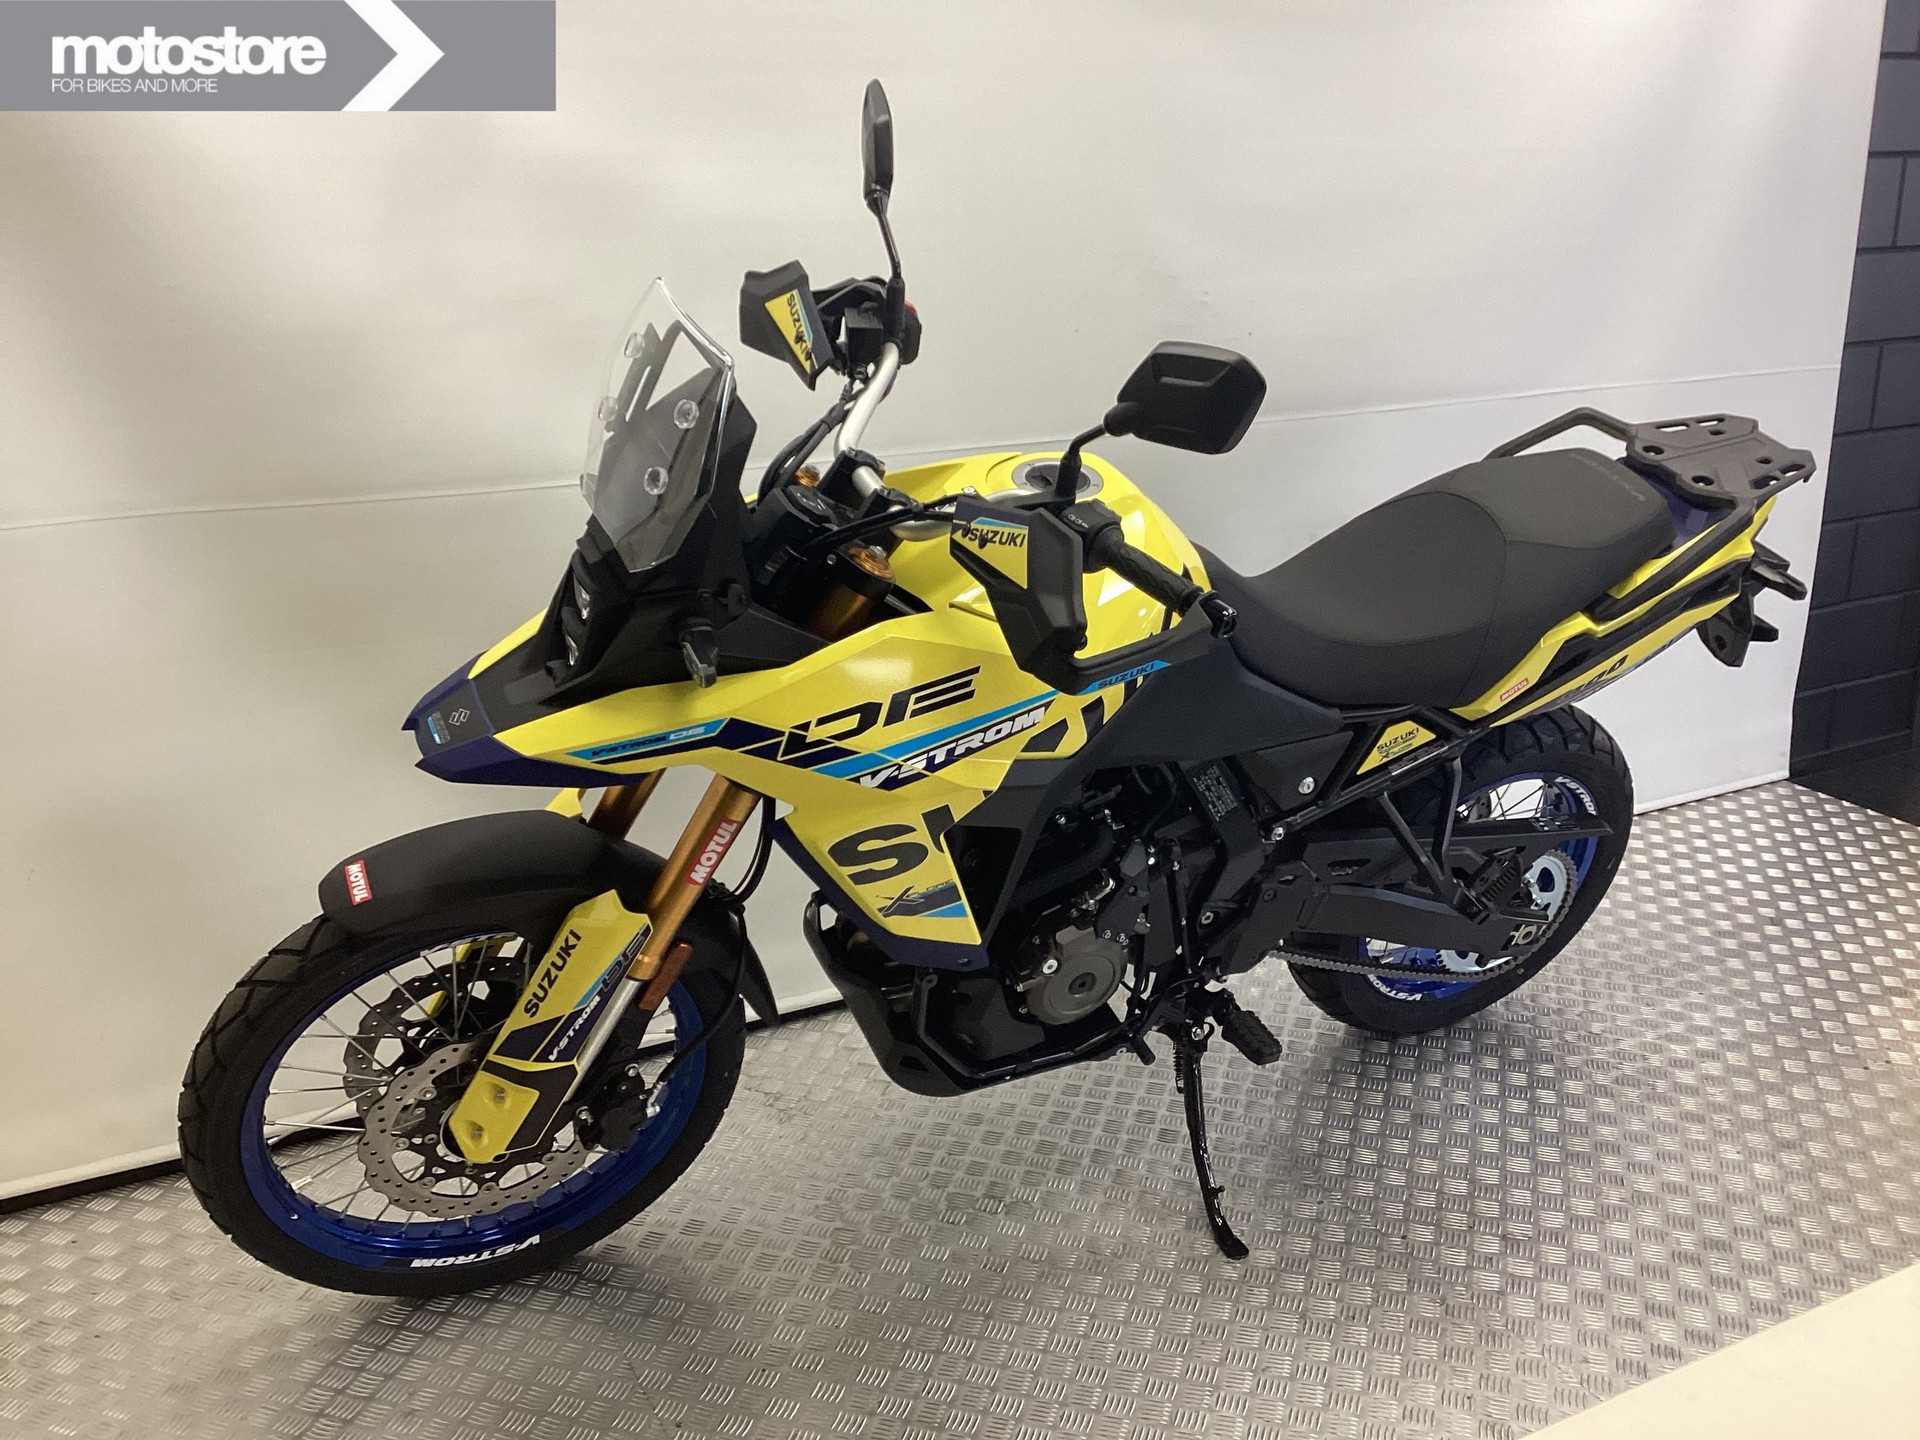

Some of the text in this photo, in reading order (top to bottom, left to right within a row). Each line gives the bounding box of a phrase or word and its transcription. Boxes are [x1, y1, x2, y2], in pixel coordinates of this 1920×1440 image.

[1097, 662, 1155, 690] SUZUKI
[859, 706, 1046, 789] V-STROM
[1376, 727, 1420, 752] SUZUKI
[690, 822, 736, 884] MOTUL
[347, 863, 370, 903] MOTUL
[523, 929, 582, 1018] SUZUKI
[548, 995, 600, 1061] V-STROM
[410, 1234, 540, 1267] V-STROM
